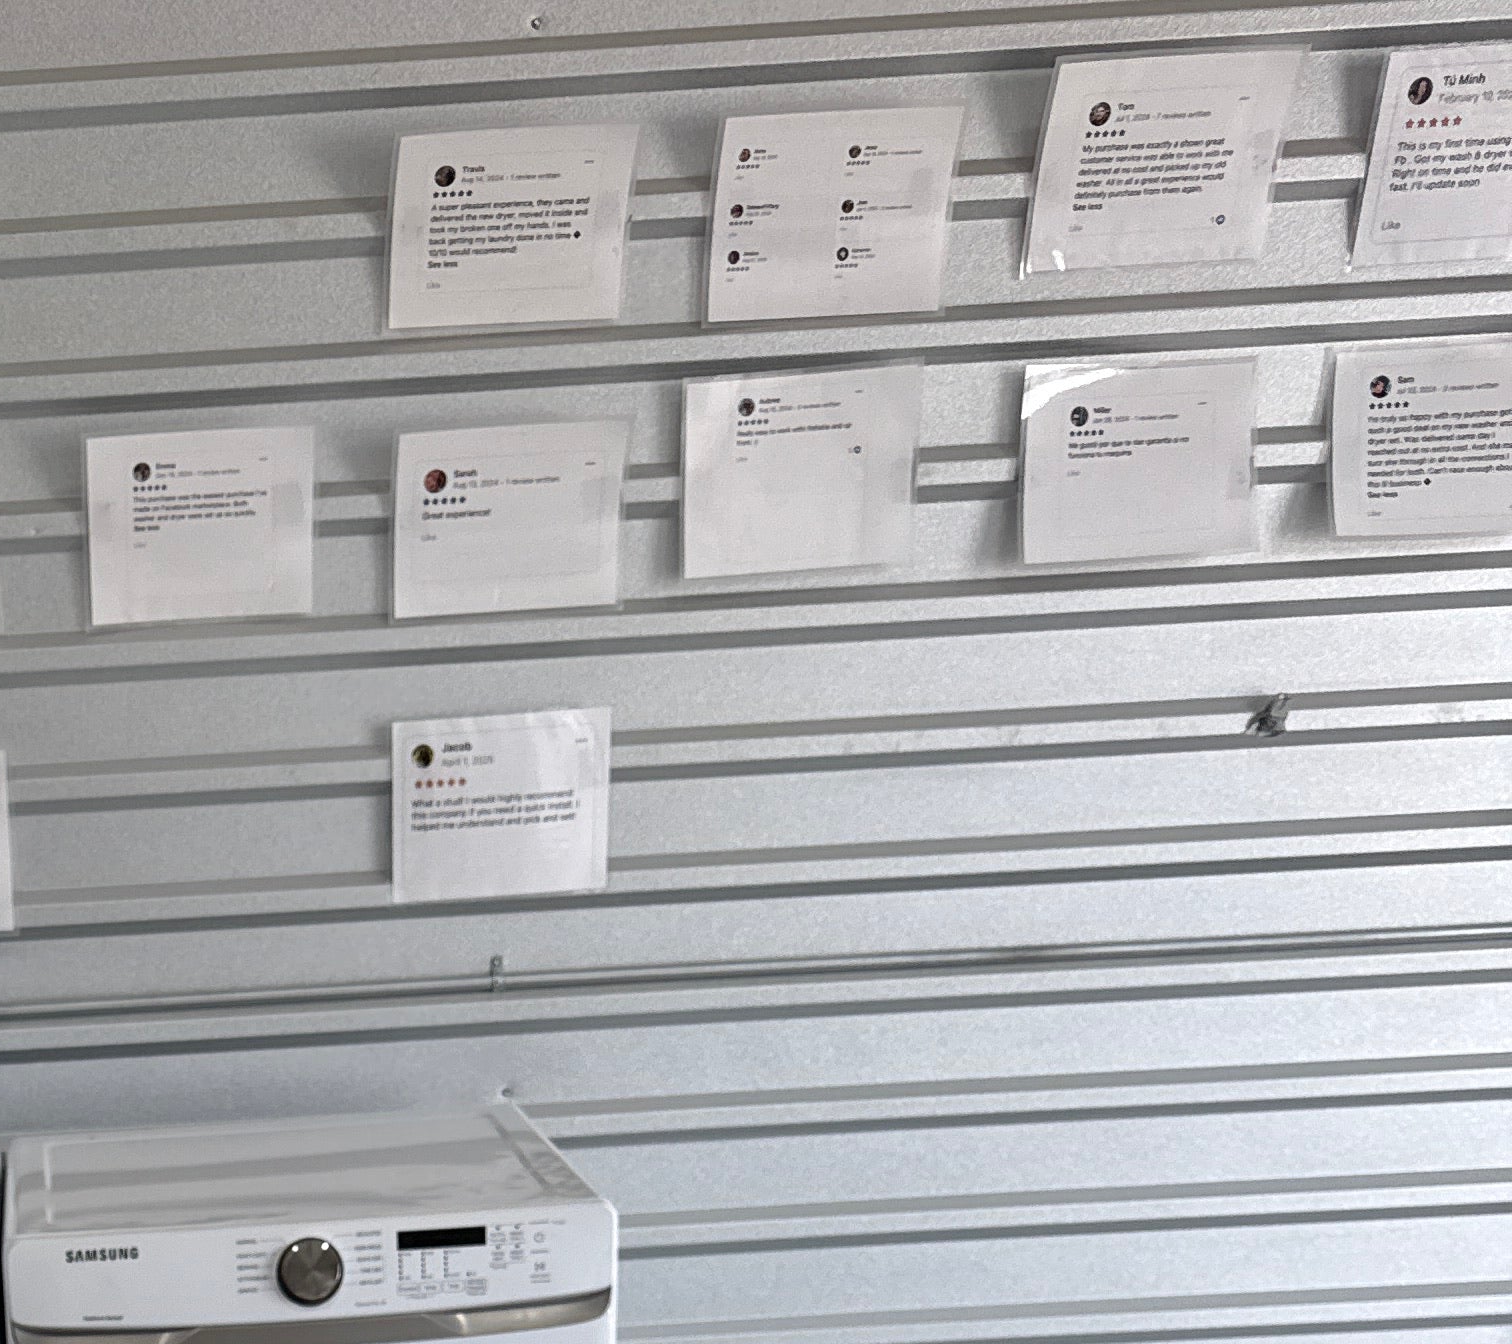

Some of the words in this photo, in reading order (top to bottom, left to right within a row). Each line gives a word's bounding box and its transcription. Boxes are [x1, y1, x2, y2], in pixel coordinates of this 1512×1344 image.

[1458, 74, 1486, 85] Minh
[1381, 221, 1401, 231] Like
[66, 1247, 138, 1263] SAMSUNG
